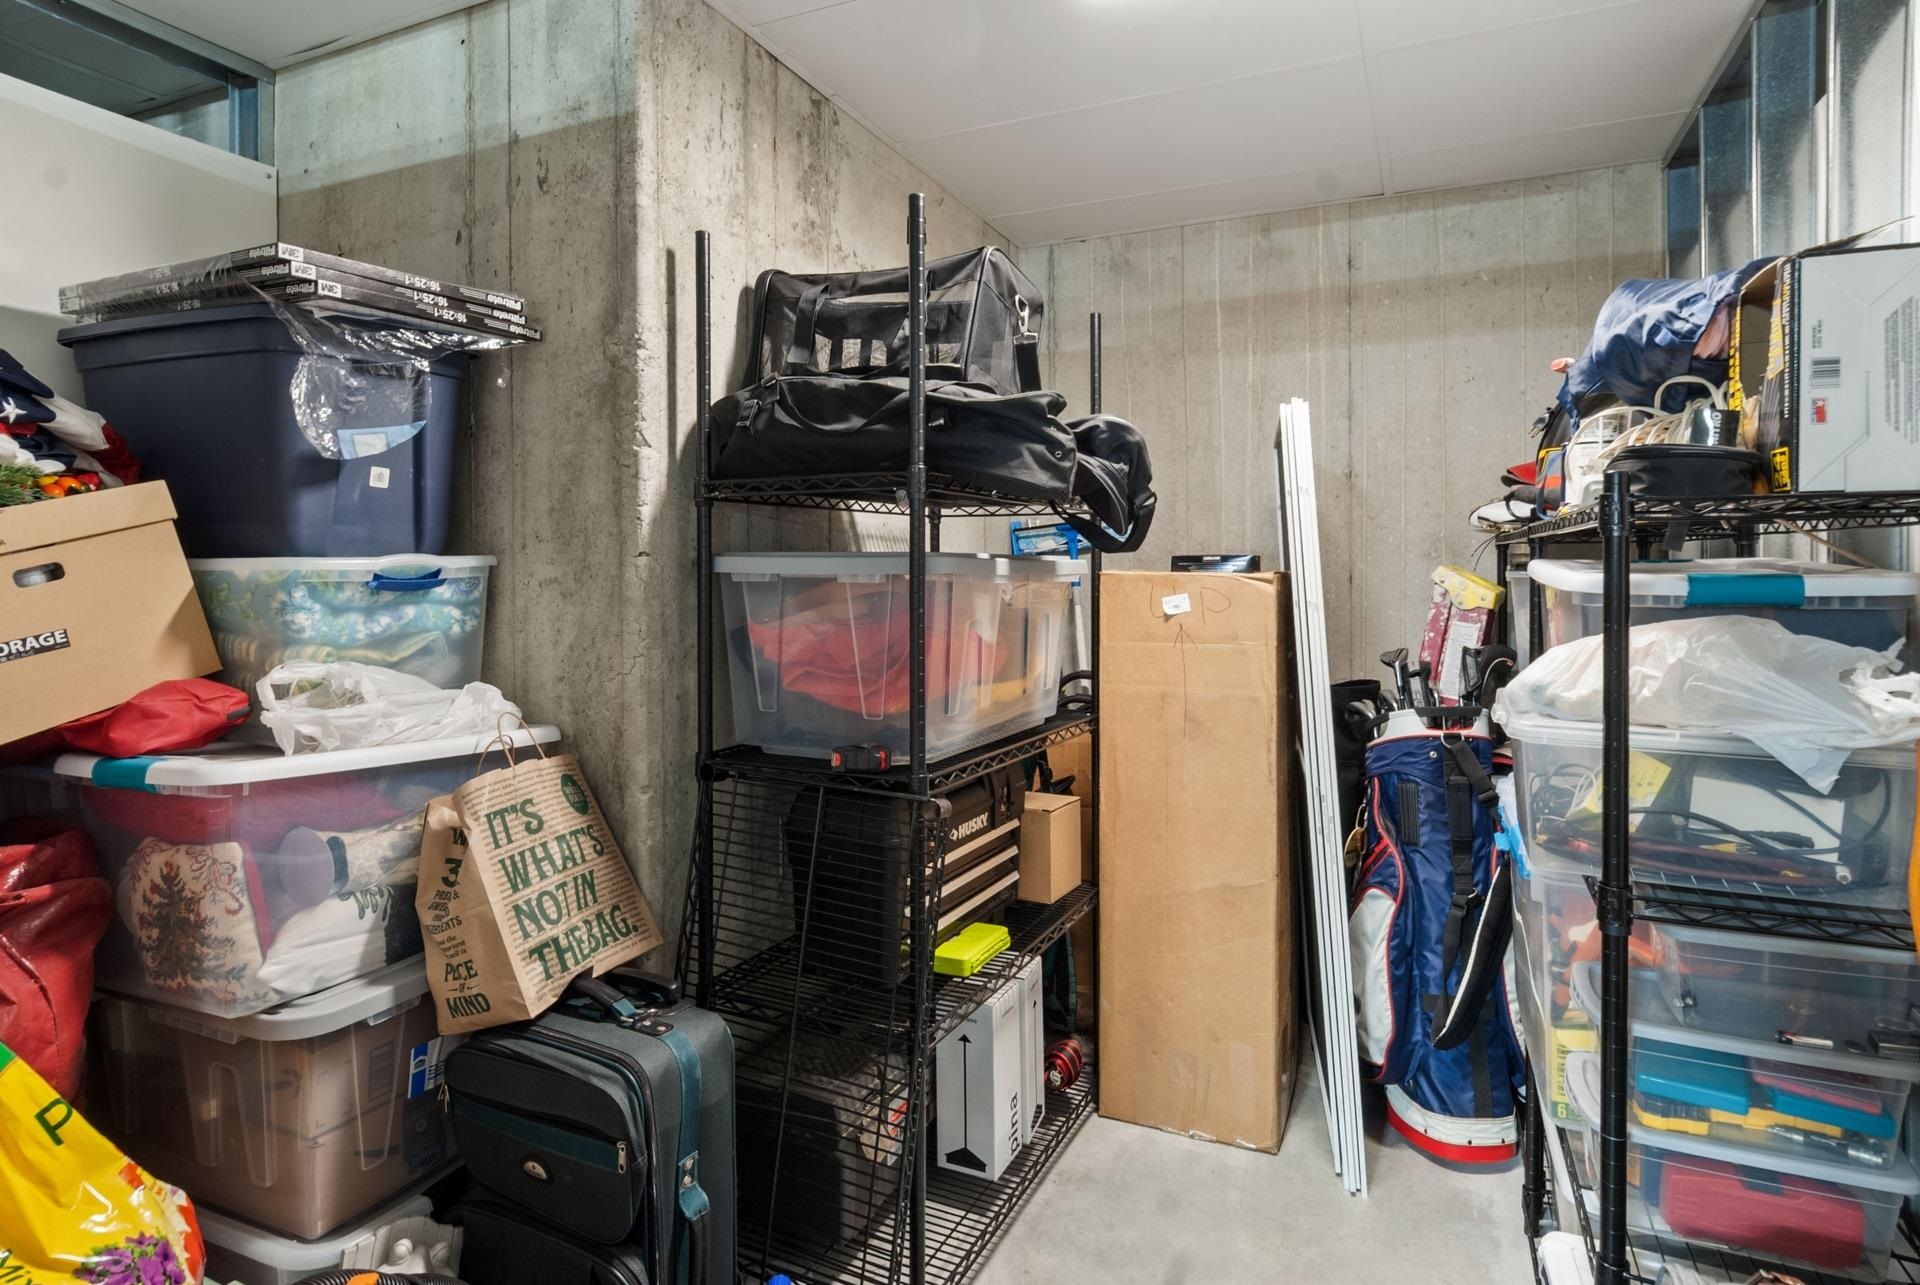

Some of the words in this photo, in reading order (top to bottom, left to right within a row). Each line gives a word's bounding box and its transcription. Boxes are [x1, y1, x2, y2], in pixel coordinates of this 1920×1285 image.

[249, 245, 276, 258] Filtrete
[281, 245, 300, 258] 3M
[261, 263, 290, 275] Filtrete
[294, 265, 313, 276] 3M
[285, 282, 316, 294] Filtrete
[320, 284, 338, 295] 3M
[404, 275, 442, 292] 16x25x1
[413, 290, 449, 307] 16x25x1
[487, 294, 522, 311] Filtrete
[433, 307, 468, 323] 16x25x1
[492, 309, 526, 325] Filtrete
[509, 324, 541, 340] Filtrete
[484, 798, 544, 849] IT'S
[958, 812, 988, 839] HUSKY
[498, 824, 604, 894] WHAT'S
[512, 880, 571, 941] NOT
[572, 869, 598, 911] IN
[528, 925, 592, 981] THE
[583, 904, 639, 954] BAG.
[446, 993, 491, 1018] MIND
